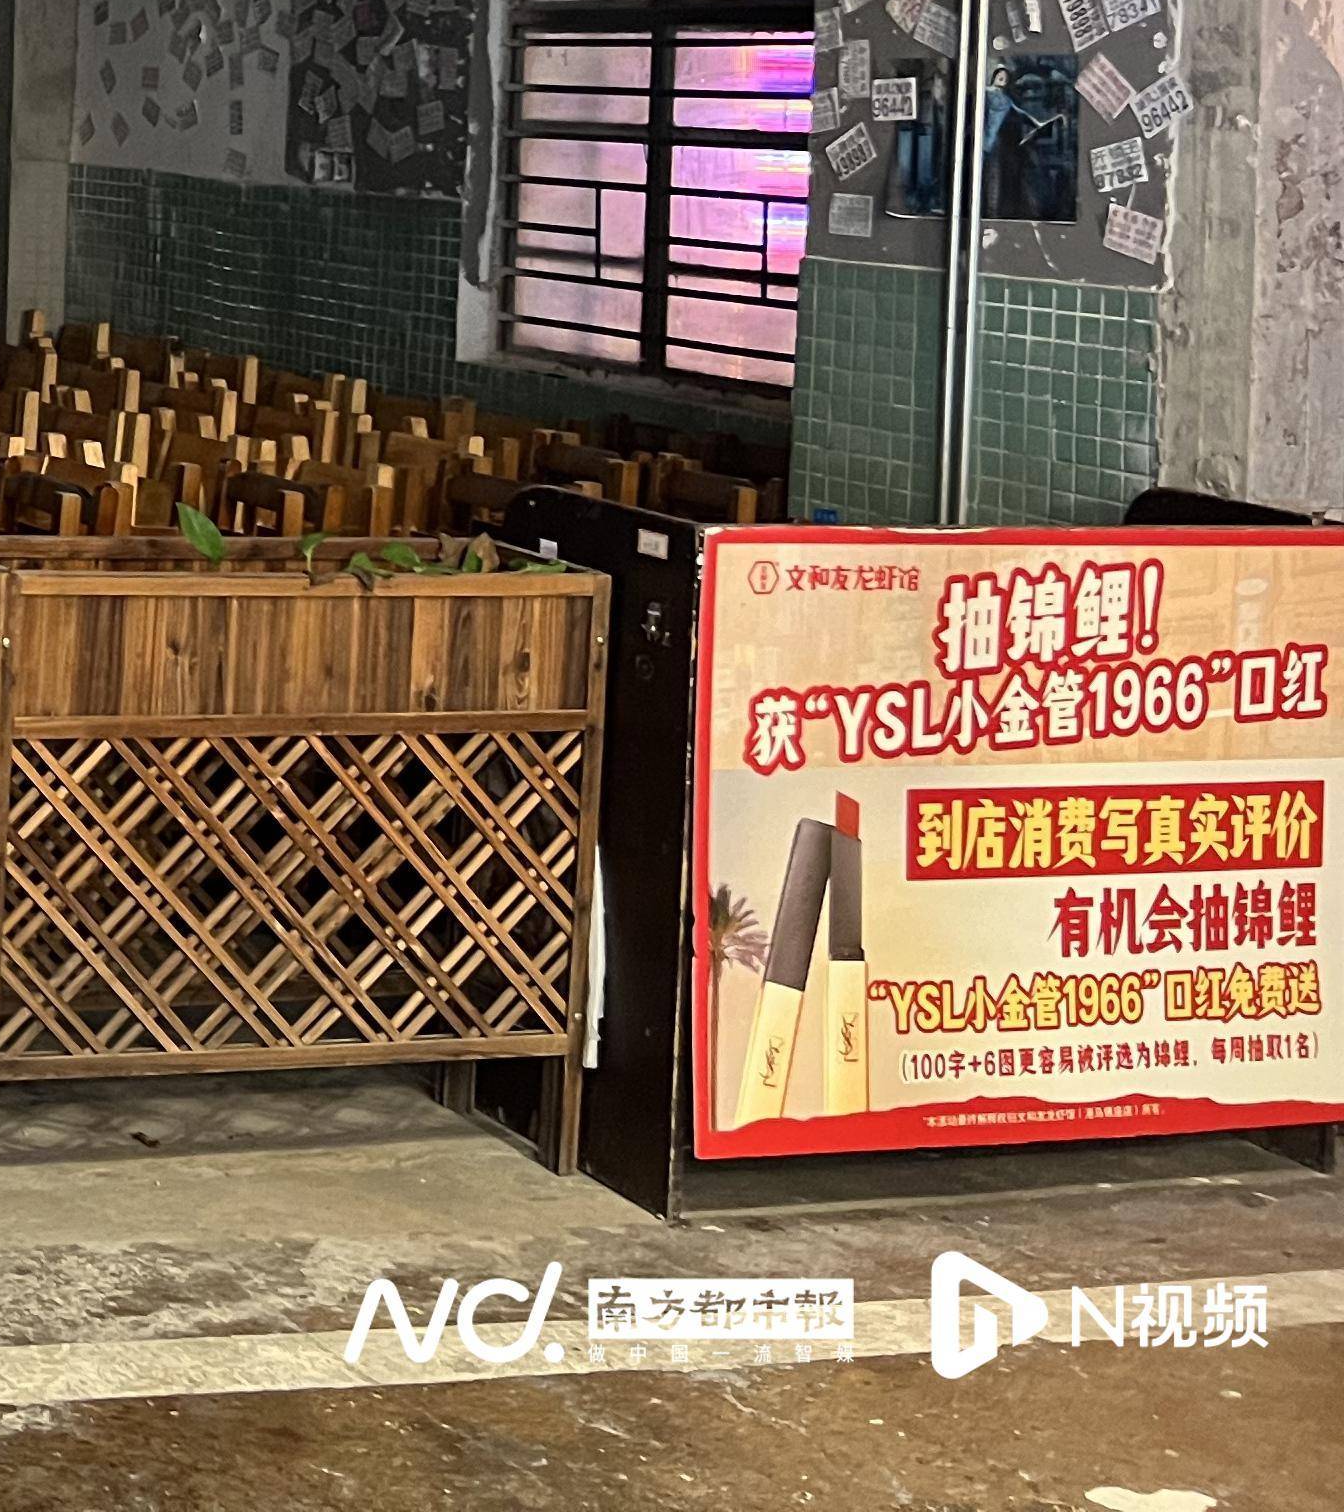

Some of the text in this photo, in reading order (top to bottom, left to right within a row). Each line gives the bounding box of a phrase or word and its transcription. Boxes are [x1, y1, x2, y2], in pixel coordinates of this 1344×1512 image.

[785, 564, 920, 592] 文和友龙虾馆
[915, 793, 1319, 872] 到店消费写真实评价
[1048, 881, 1319, 958] 有机会抽锦鲤
